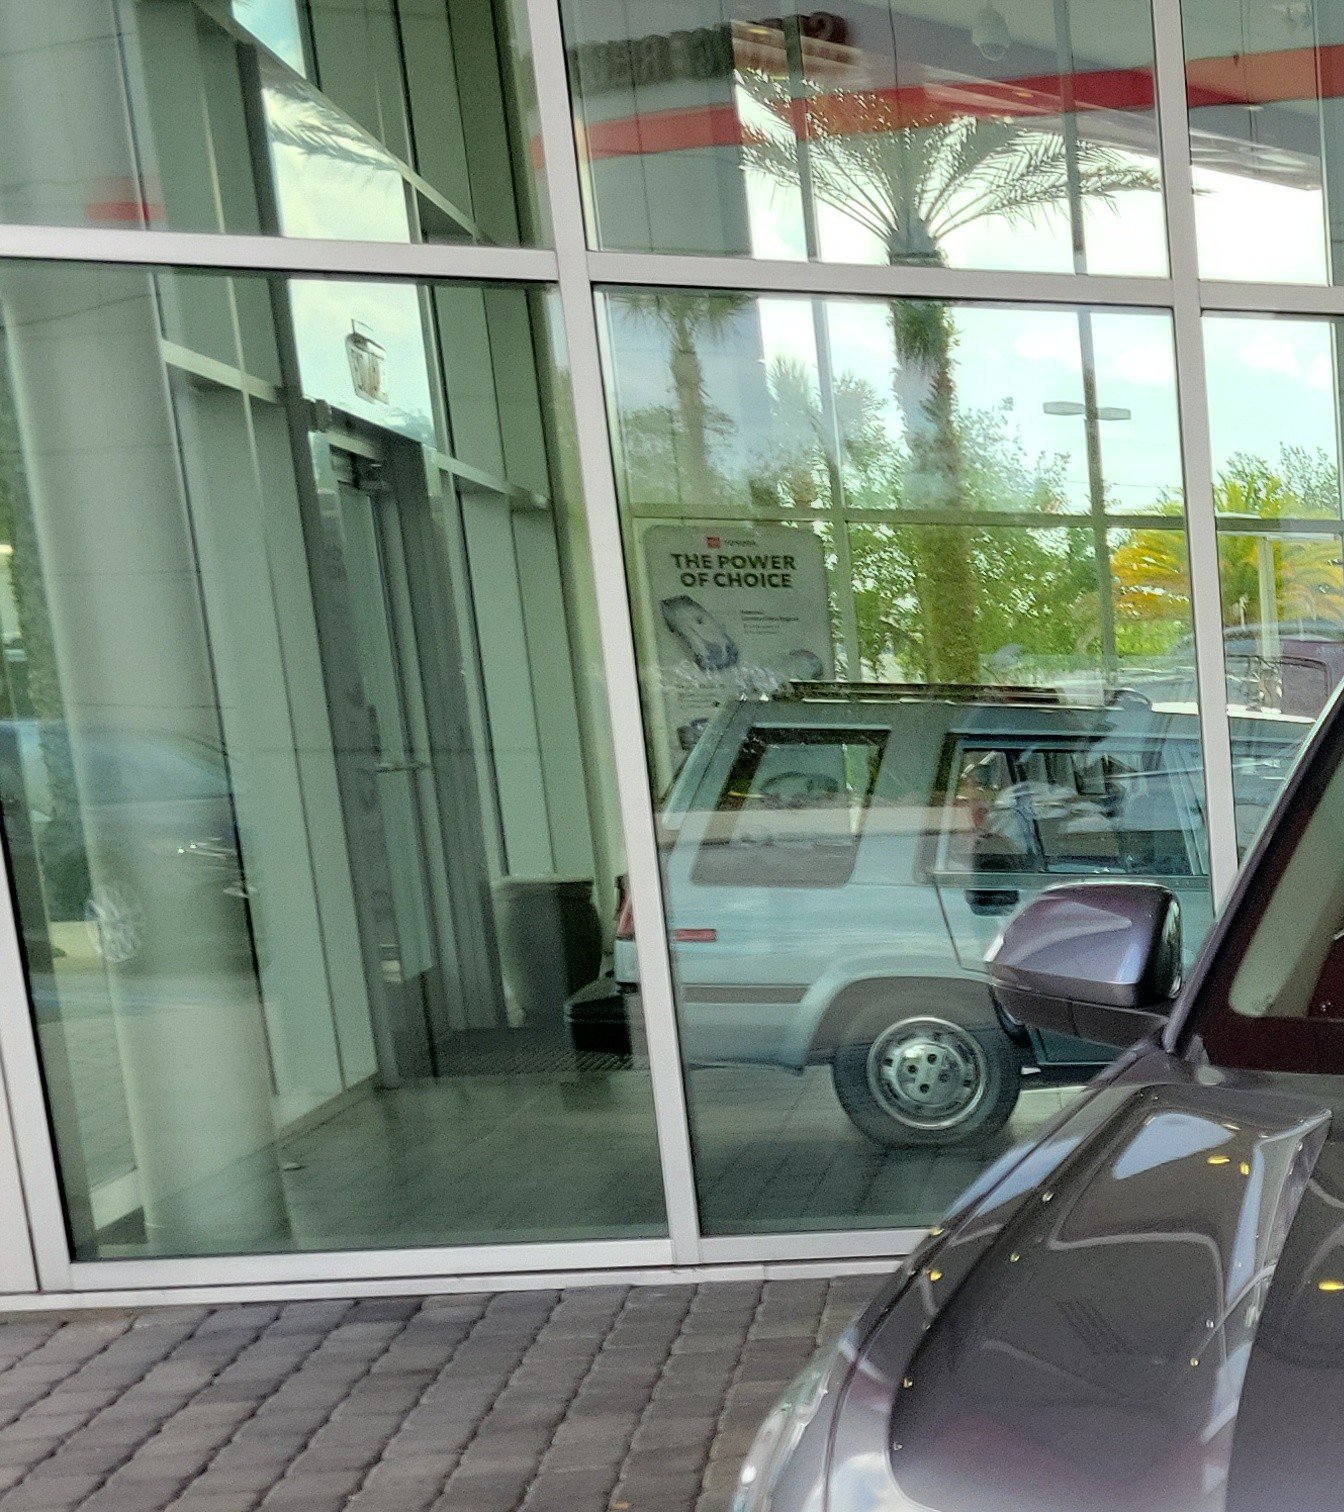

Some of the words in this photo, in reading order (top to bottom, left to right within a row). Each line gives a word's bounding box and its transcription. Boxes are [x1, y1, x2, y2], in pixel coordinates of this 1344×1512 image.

[671, 553, 712, 569] THE
[717, 554, 797, 570] POWER
[681, 573, 709, 587] OF
[713, 572, 793, 588] CHOICE
